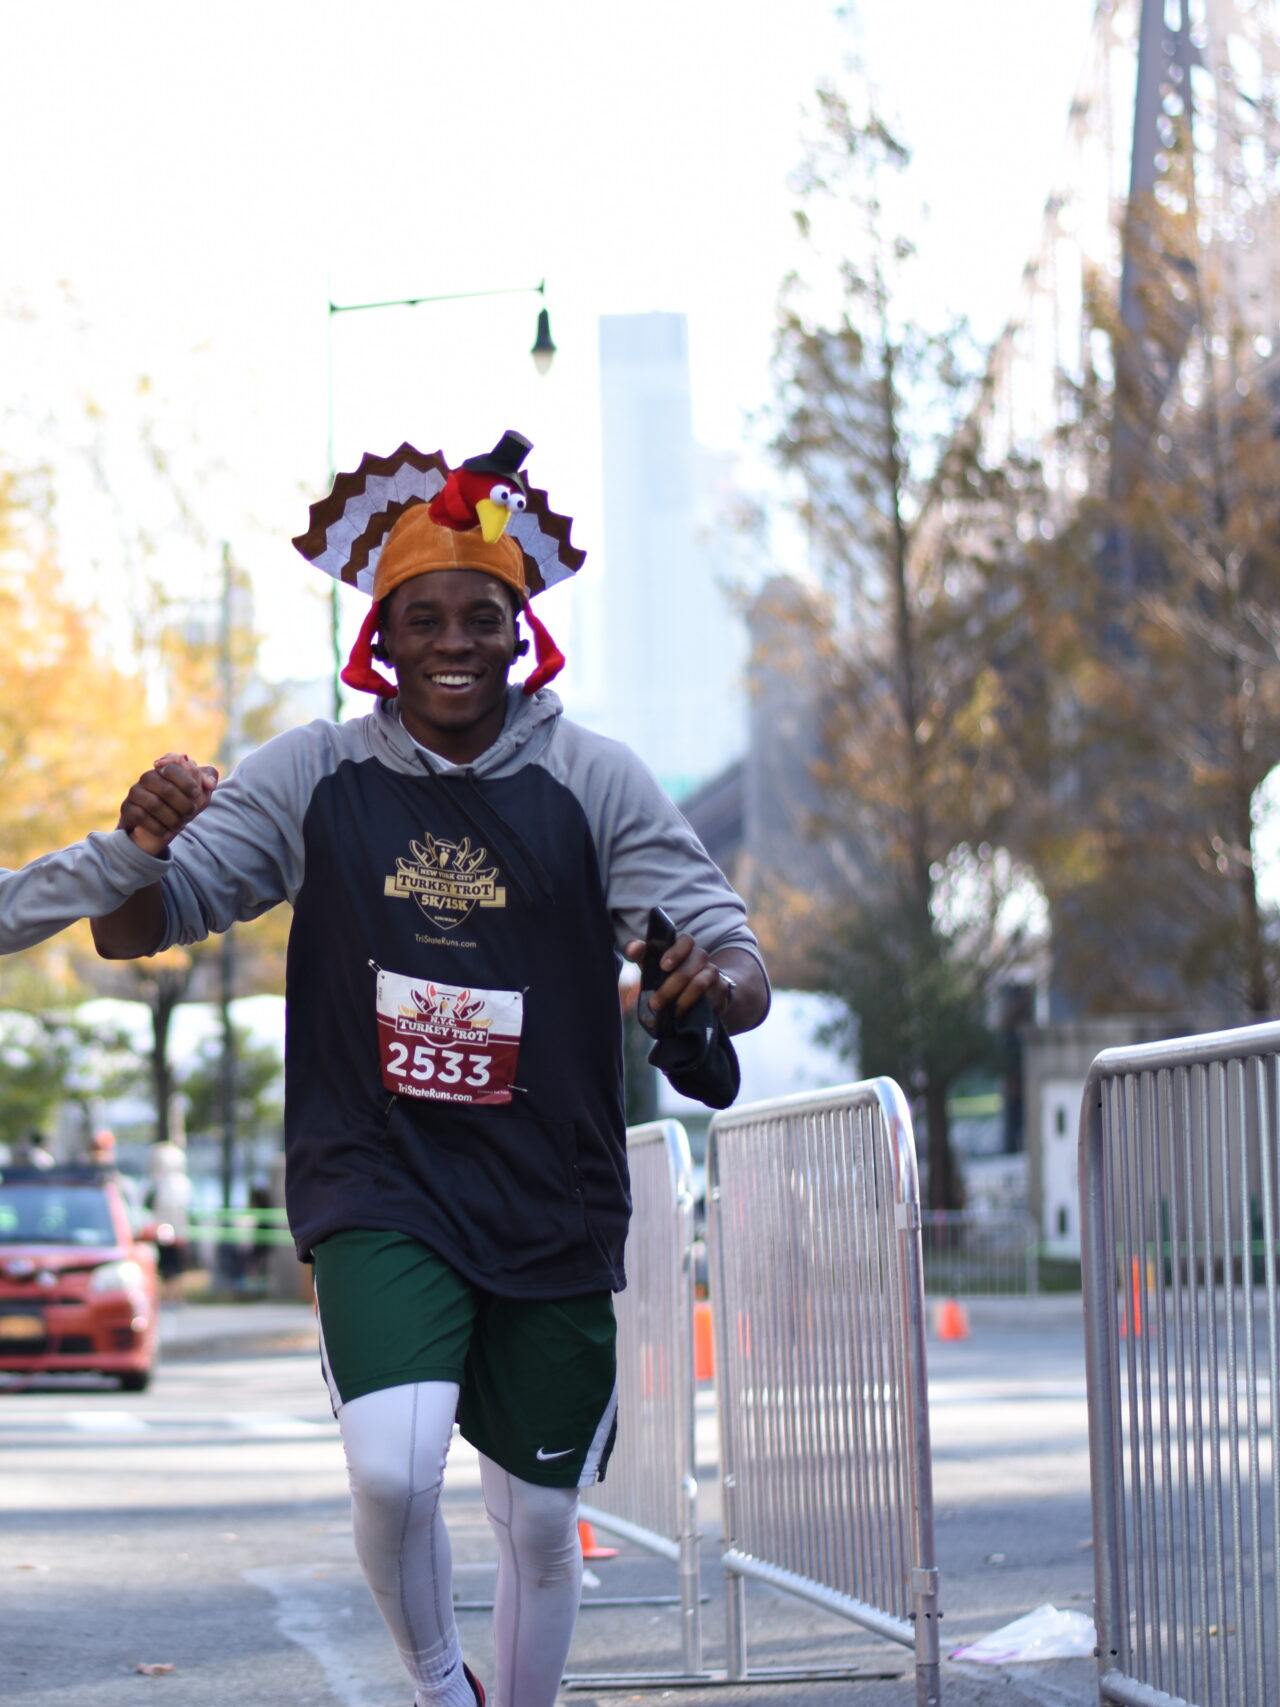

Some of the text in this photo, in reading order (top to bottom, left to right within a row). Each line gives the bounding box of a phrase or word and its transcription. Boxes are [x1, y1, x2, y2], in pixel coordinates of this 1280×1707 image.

[420, 868, 438, 877] NEW
[456, 874, 474, 883] CITY
[399, 874, 492, 896] TURKEY TROT
[421, 894, 469, 911] 5K/15K
[414, 933, 477, 948] TriStateRuns.com
[399, 1018, 486, 1042] TURKEY TROT
[430, 1015, 457, 1027] N.Y.C.
[386, 1041, 492, 1087] 2533
[397, 1082, 472, 1102] TriStateRuns.com
